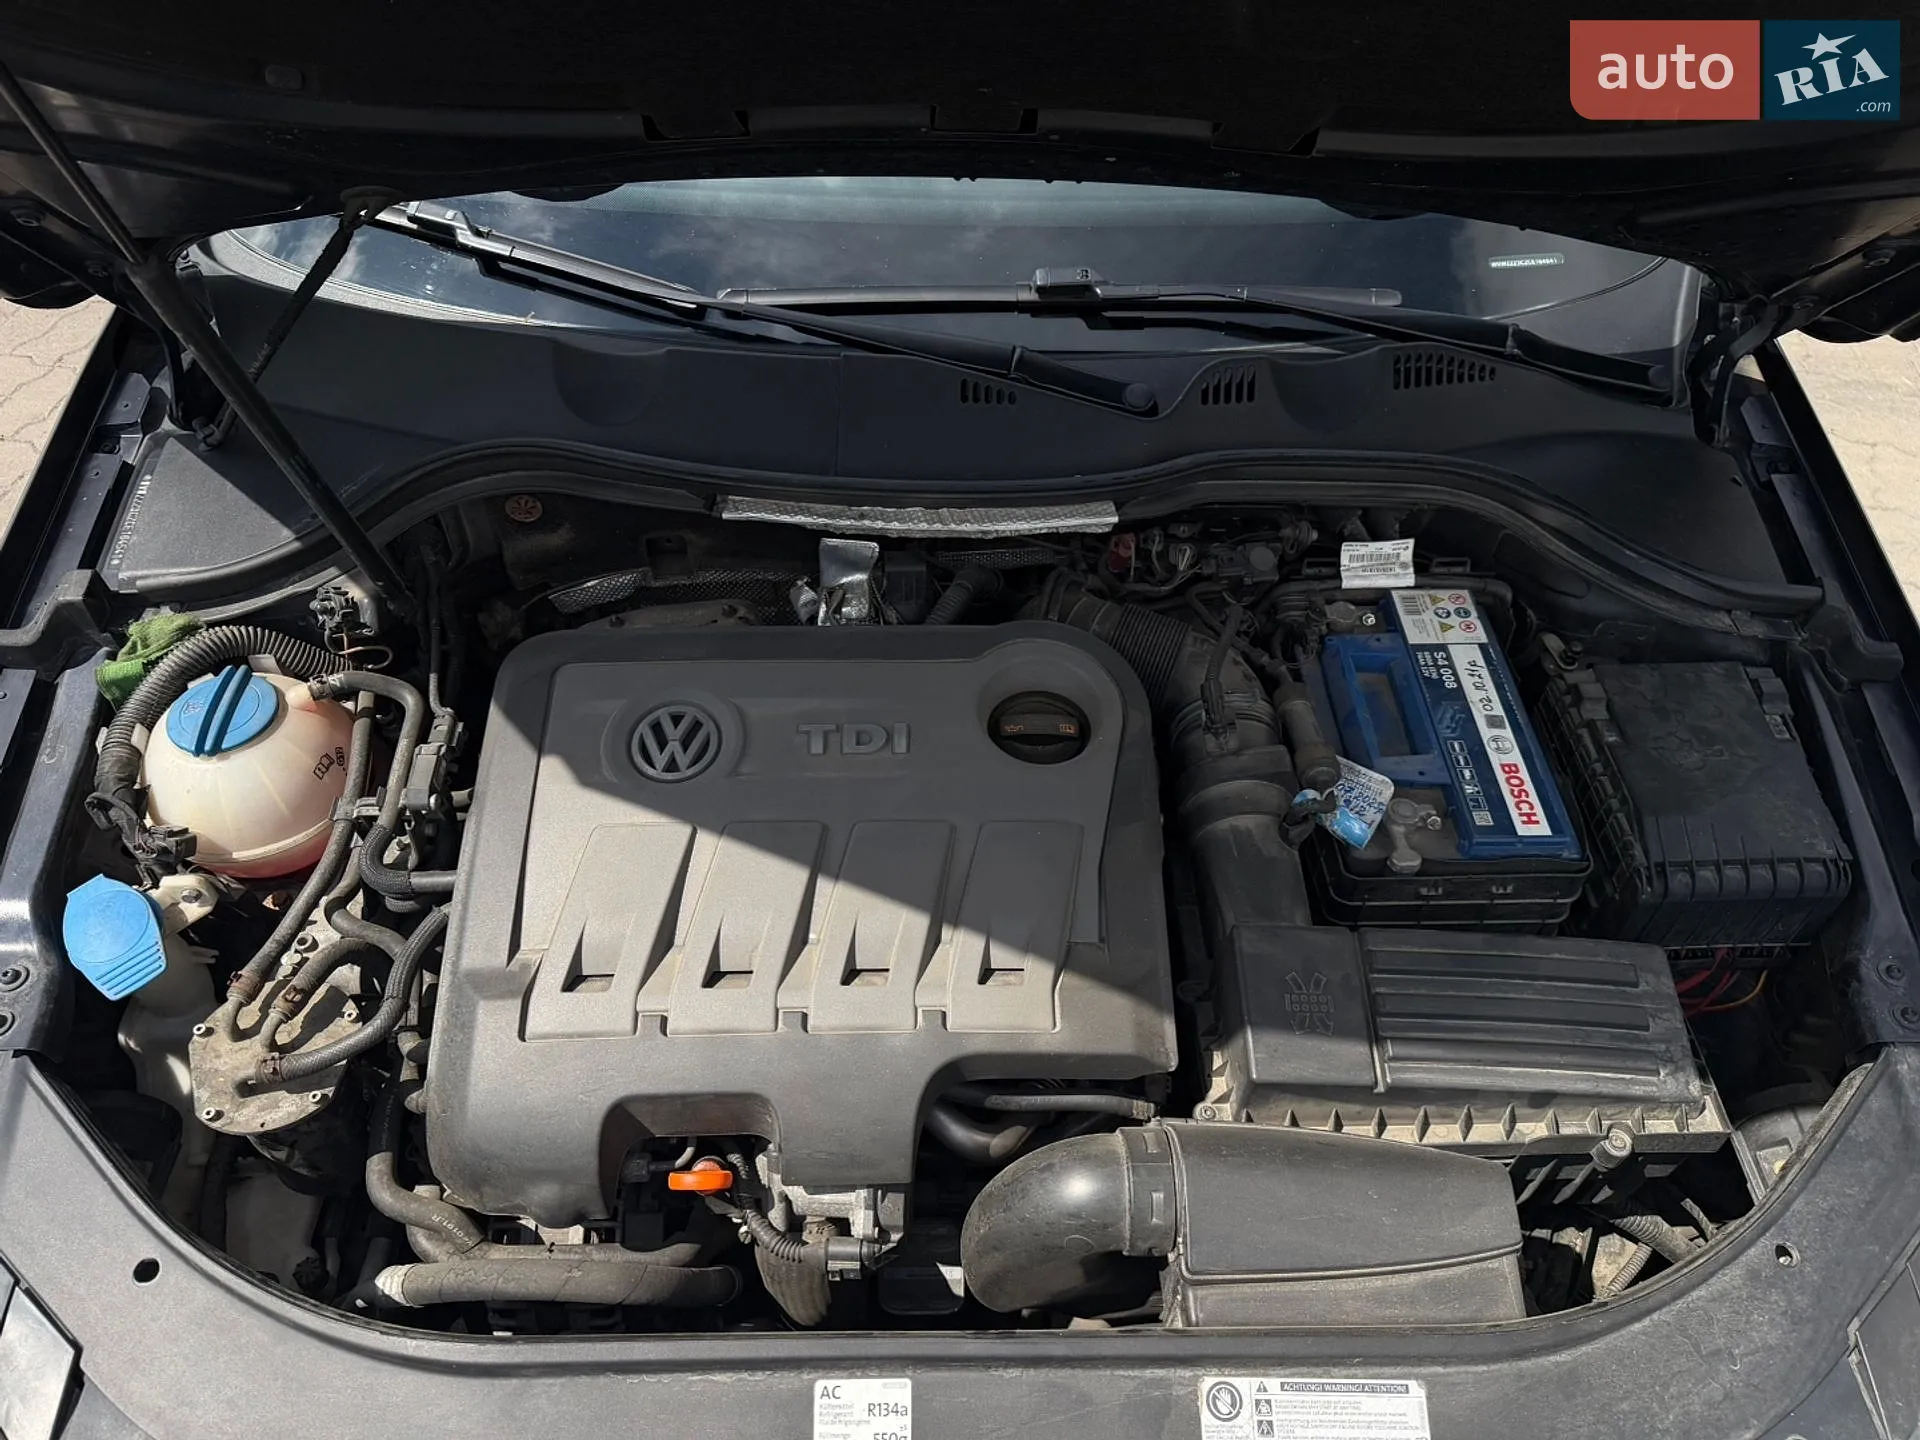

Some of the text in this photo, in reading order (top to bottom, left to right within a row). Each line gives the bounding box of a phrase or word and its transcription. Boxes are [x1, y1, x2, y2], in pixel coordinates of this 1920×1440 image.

[1434, 652, 1457, 688] S4 008
[798, 722, 911, 755] TDI
[1501, 763, 1541, 826] BOSCH
[820, 1385, 841, 1400] AC
[868, 1402, 908, 1417] R134a
